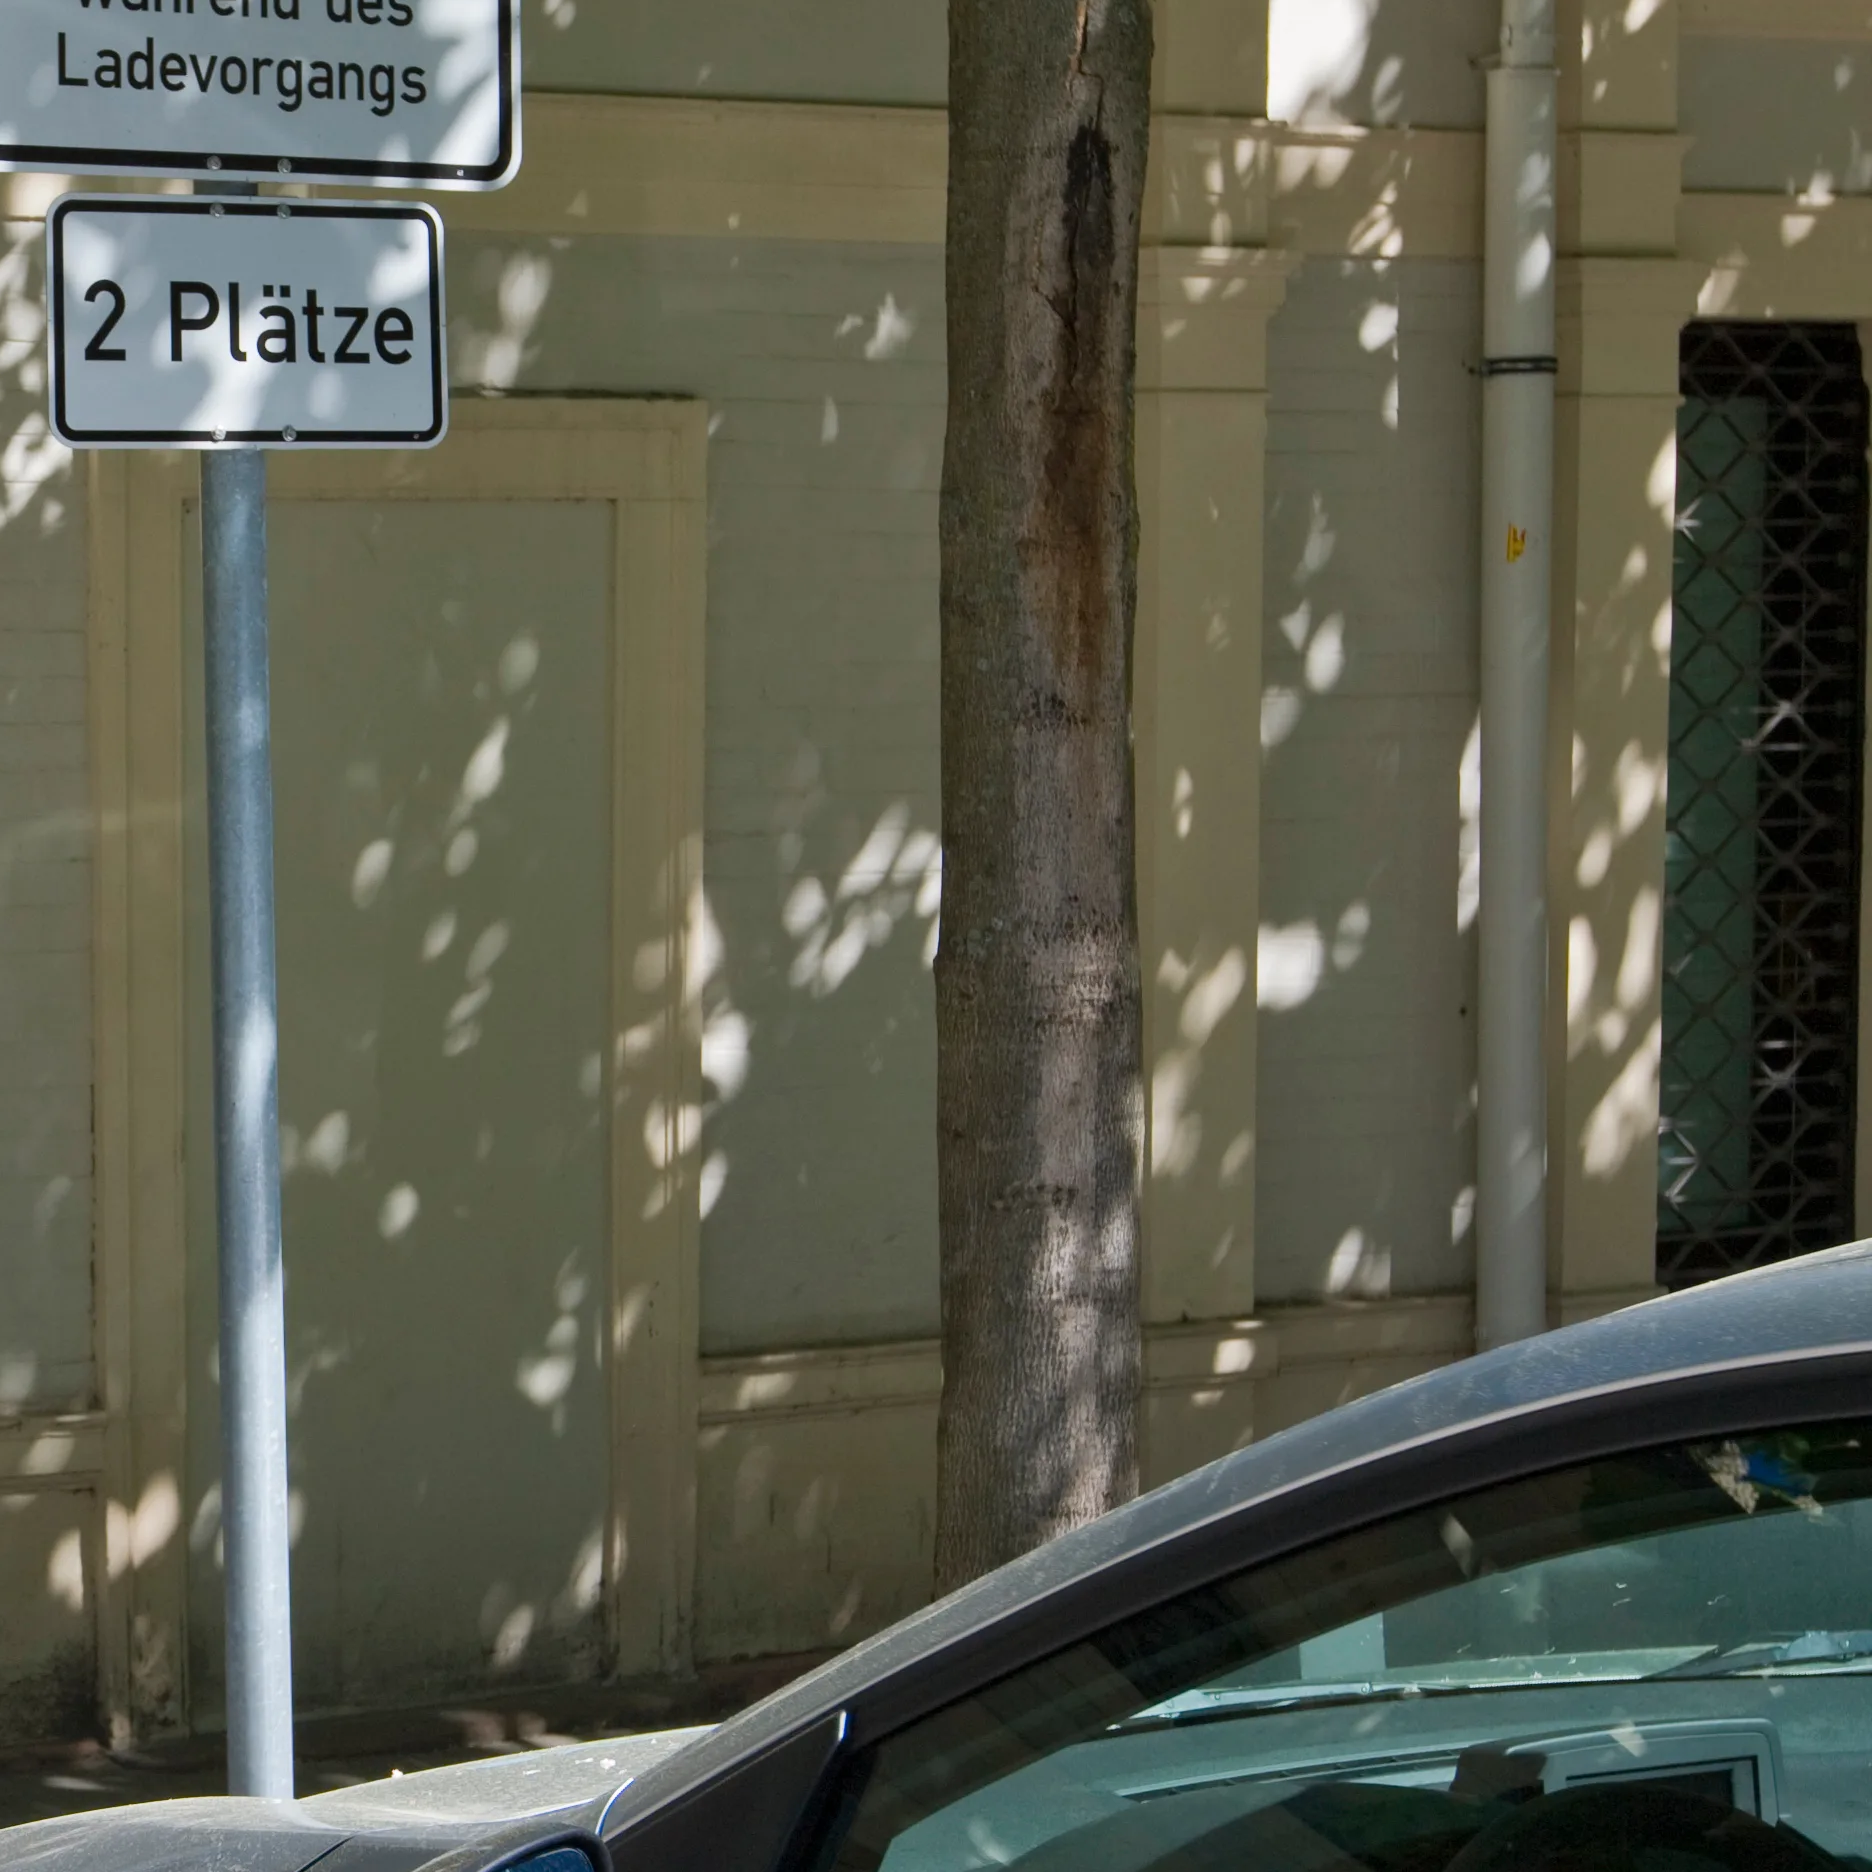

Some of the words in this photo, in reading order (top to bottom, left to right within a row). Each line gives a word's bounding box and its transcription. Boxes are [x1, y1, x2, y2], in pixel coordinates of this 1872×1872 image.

[57, 31, 428, 118] Ladevorgangs
[83, 279, 127, 362] 2
[169, 280, 415, 366] Plätze
